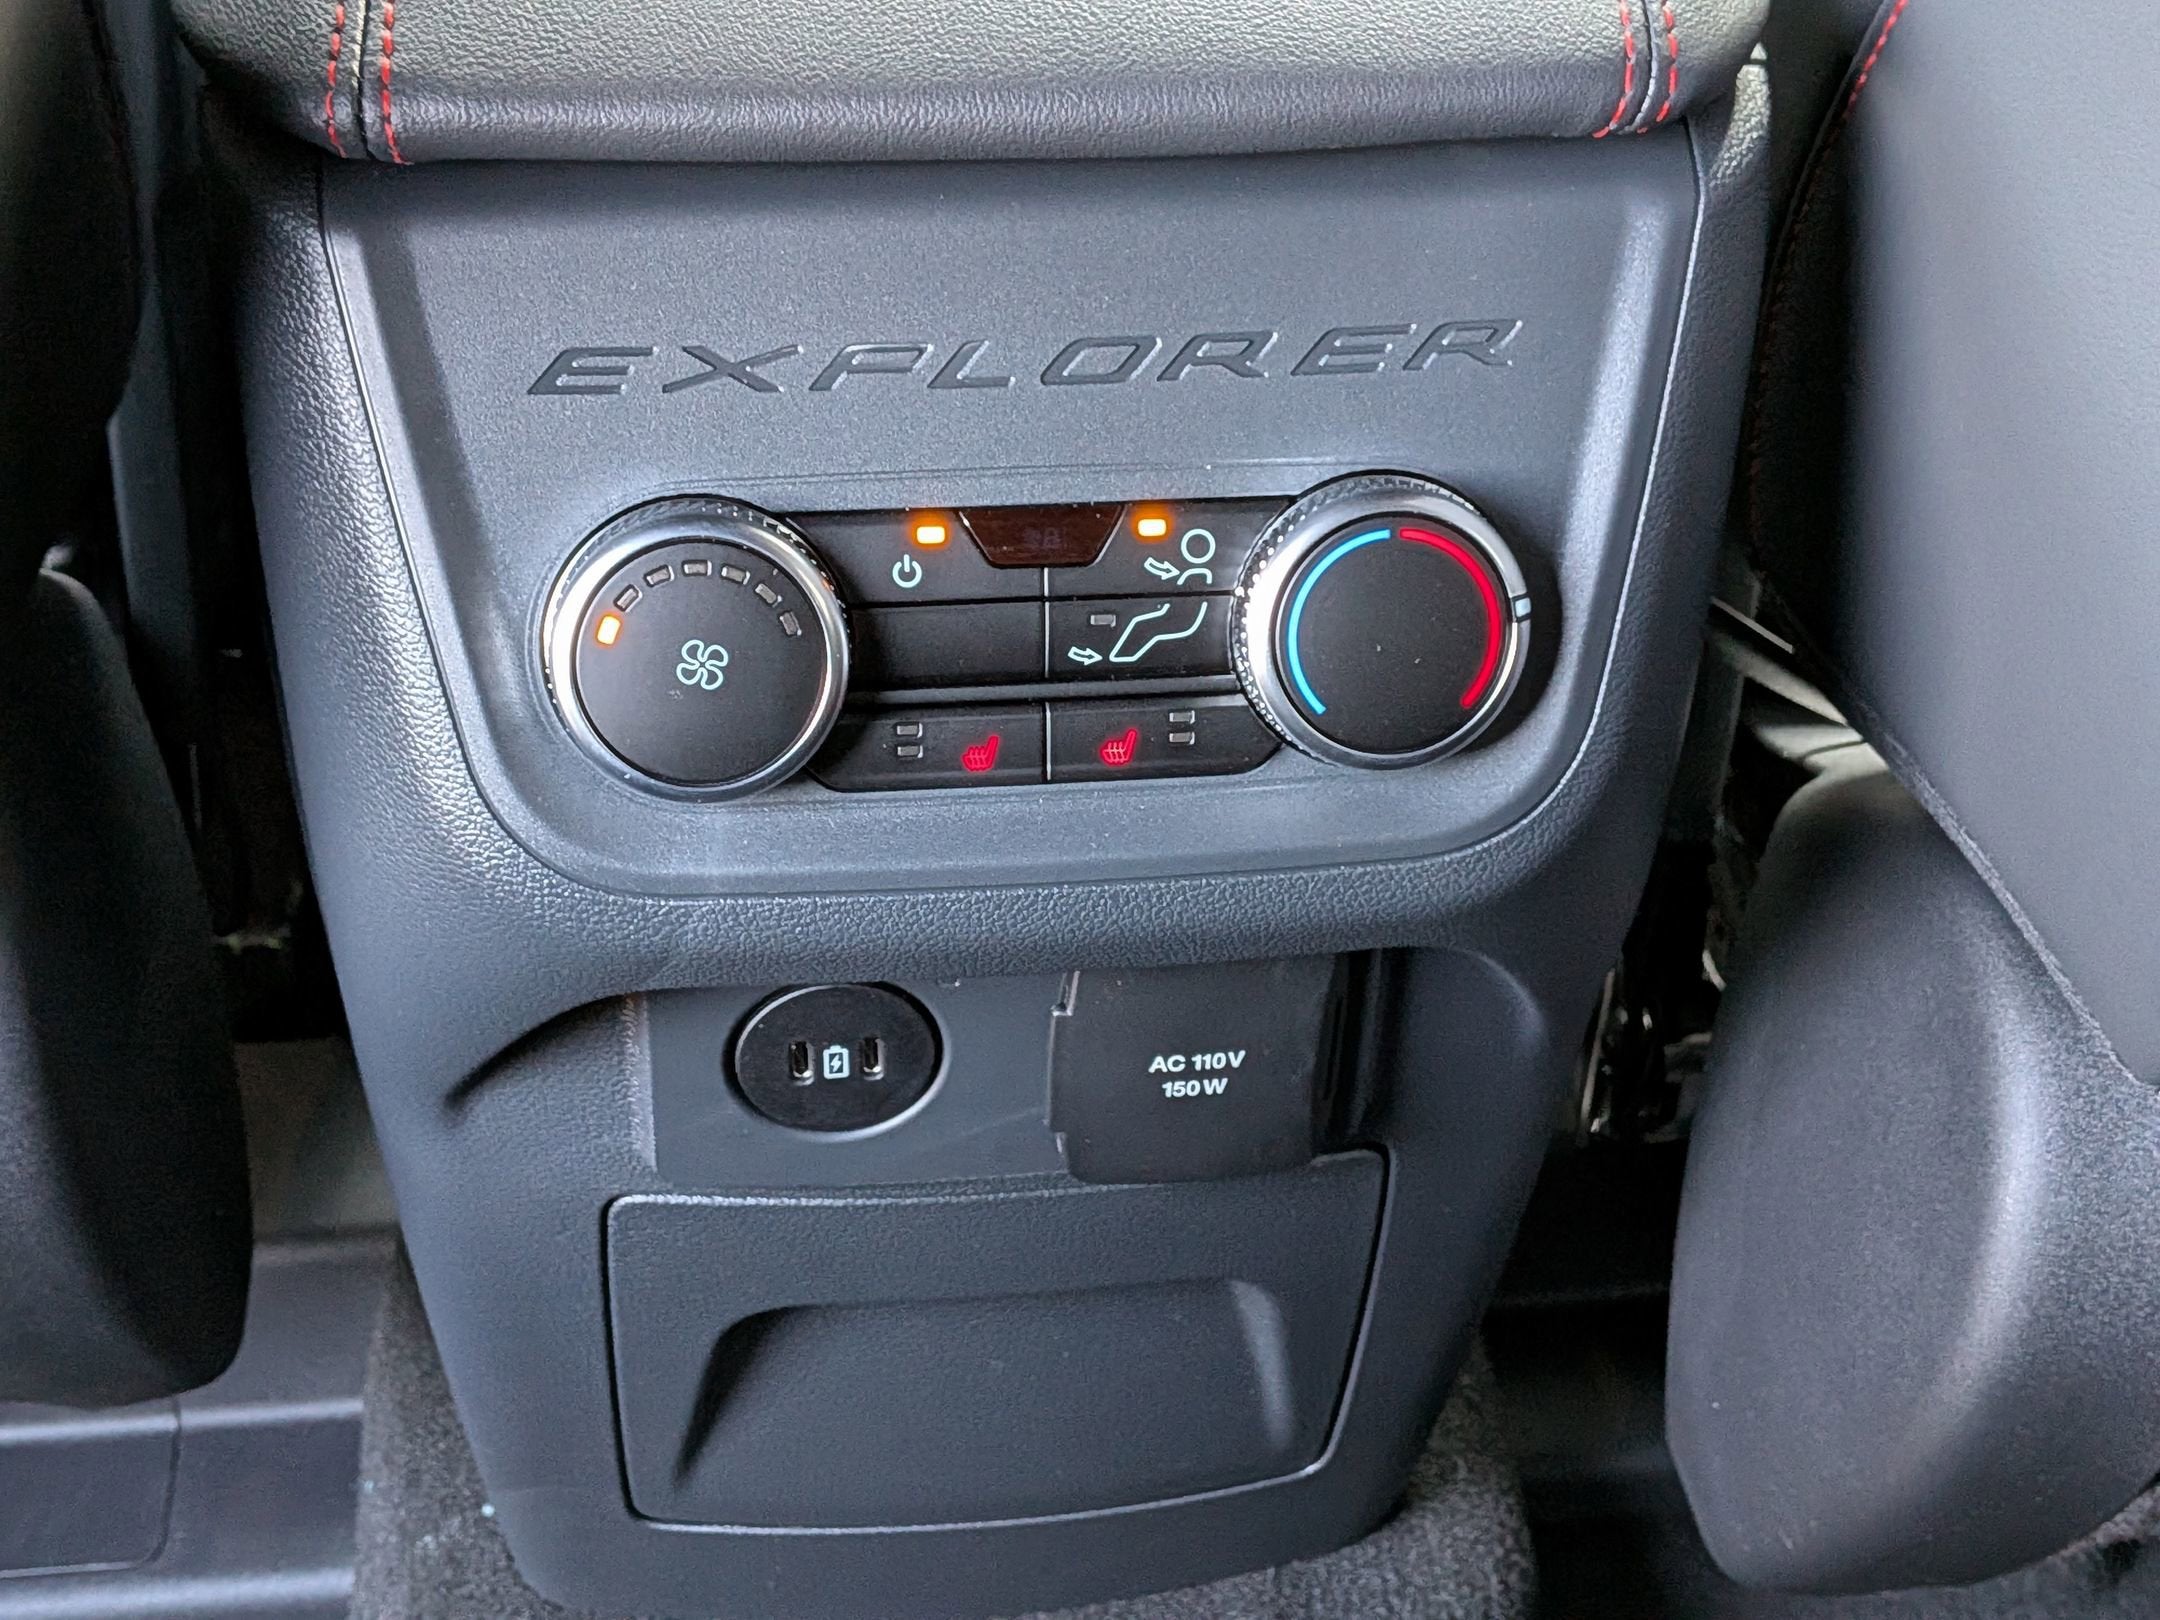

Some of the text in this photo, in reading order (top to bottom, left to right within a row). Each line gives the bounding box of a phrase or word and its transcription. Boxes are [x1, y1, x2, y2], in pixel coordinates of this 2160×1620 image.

[527, 319, 1524, 396] EXPLORER
[1148, 1050, 1246, 1073] AC 110V
